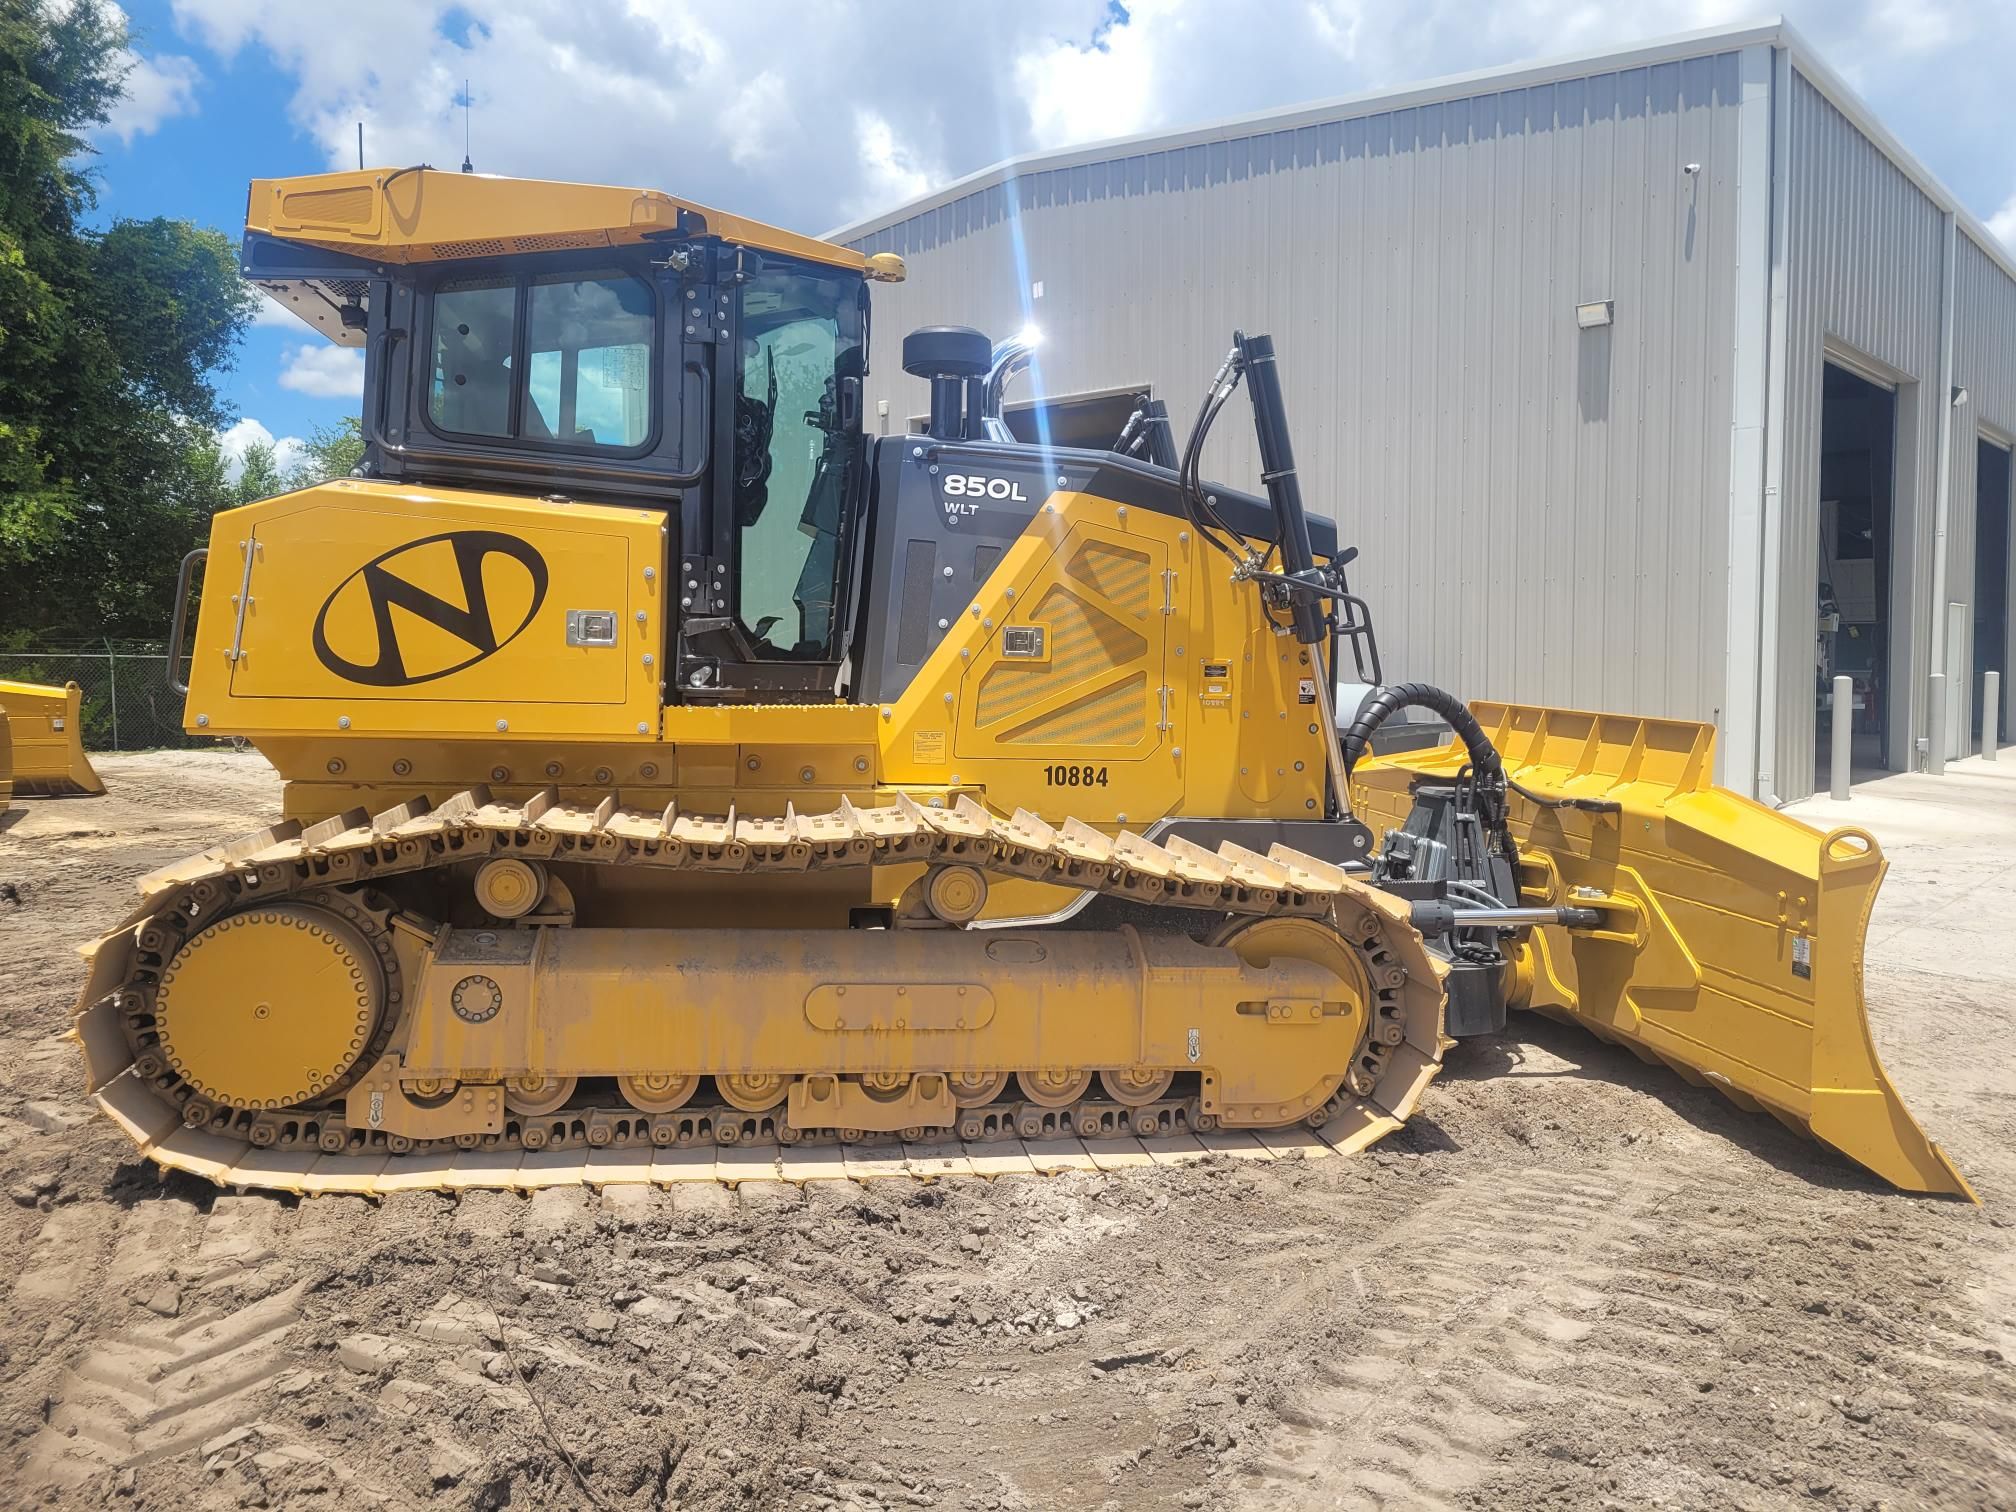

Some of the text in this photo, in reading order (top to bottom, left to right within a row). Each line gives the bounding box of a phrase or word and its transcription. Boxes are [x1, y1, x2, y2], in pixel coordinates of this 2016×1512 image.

[943, 474, 1028, 502] 850L
[944, 502, 980, 516] WLT
[1043, 765, 1109, 787] 10884
